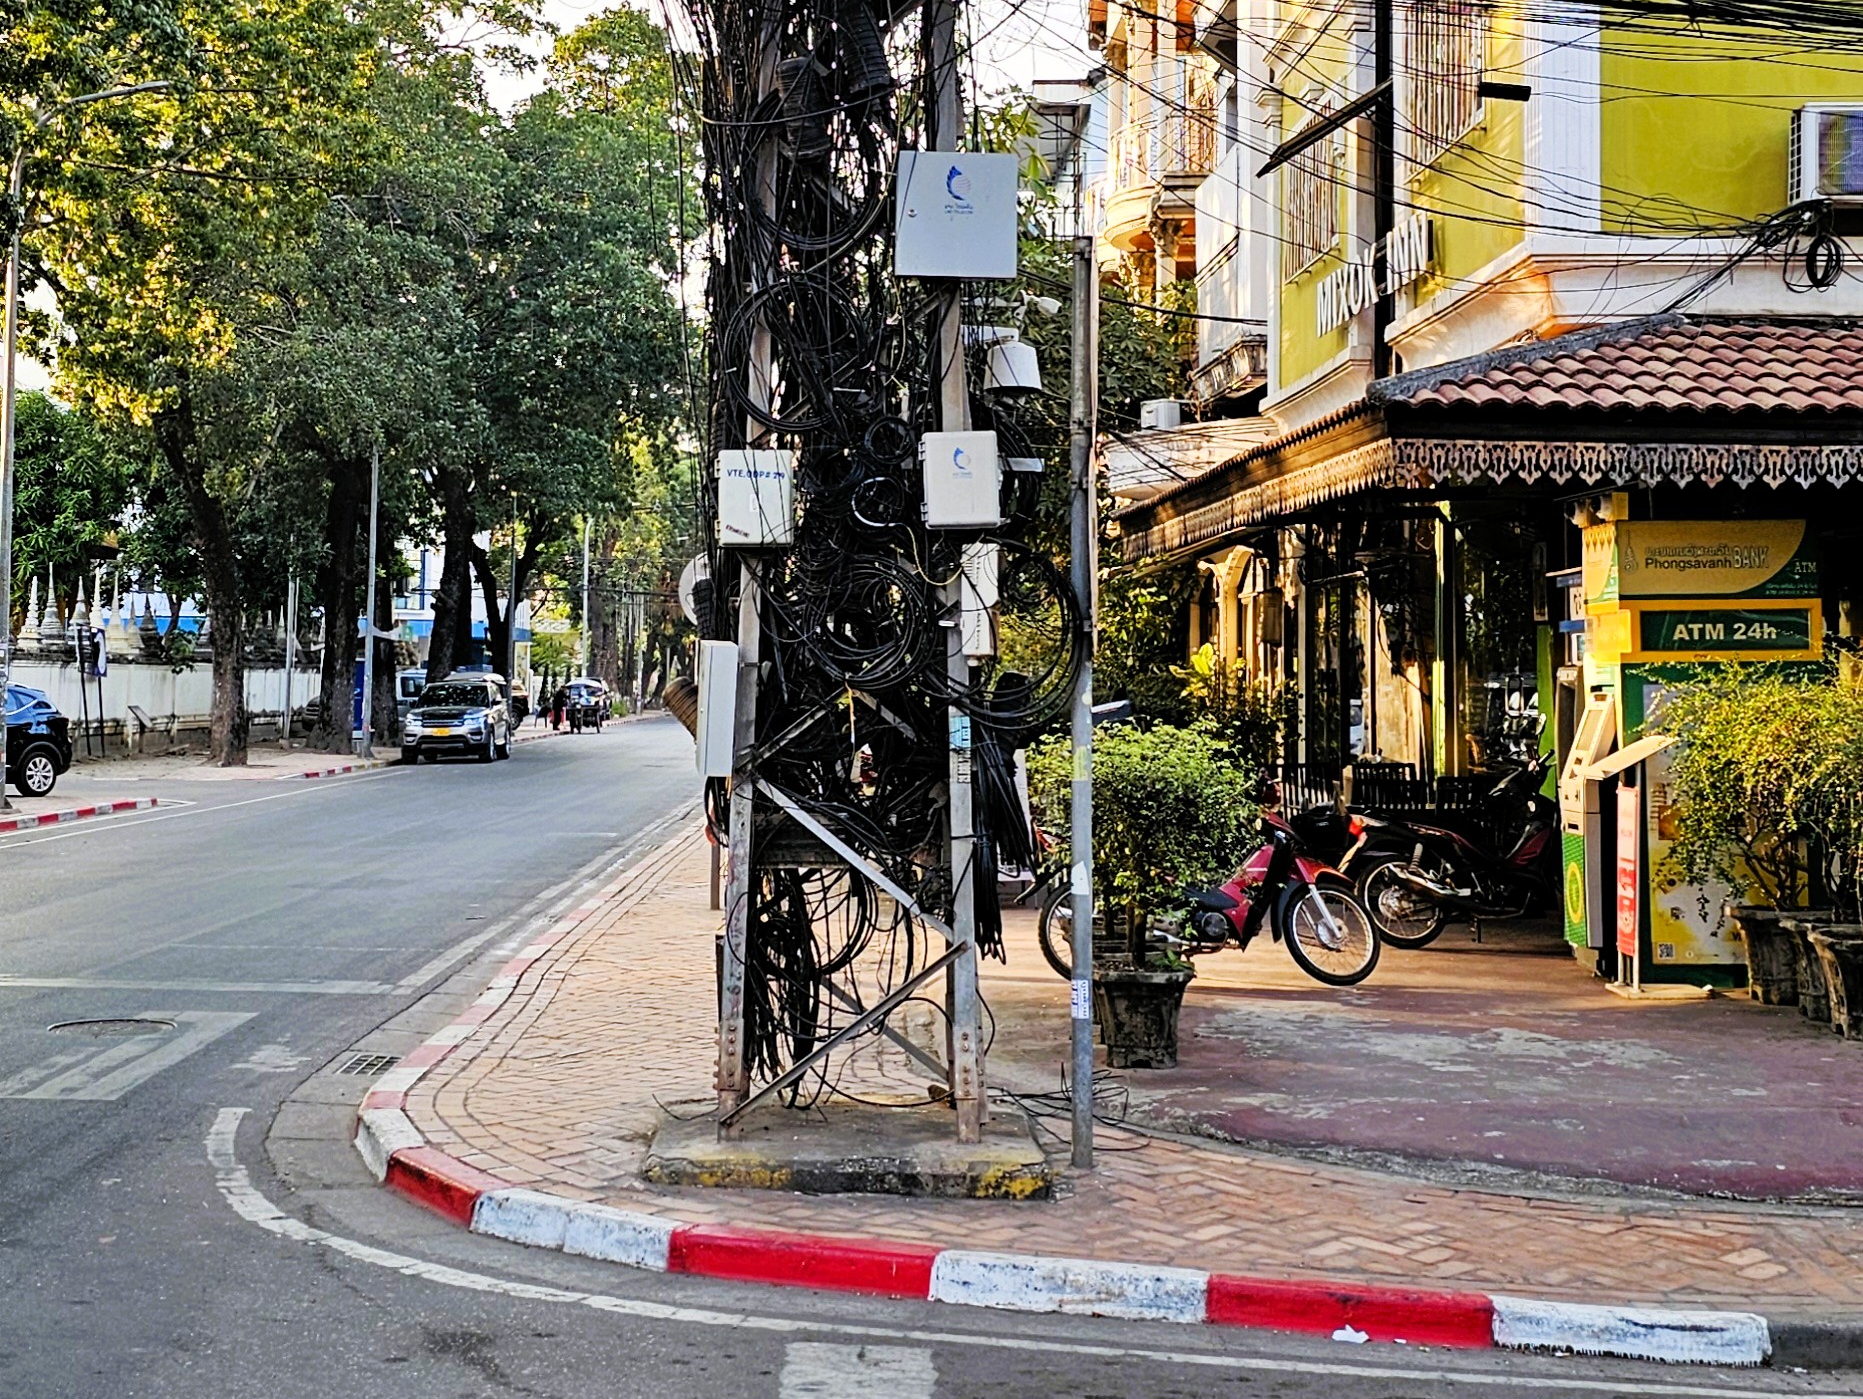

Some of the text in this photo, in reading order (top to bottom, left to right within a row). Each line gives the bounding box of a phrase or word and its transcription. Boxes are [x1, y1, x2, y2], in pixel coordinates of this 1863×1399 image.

[1317, 211, 1428, 338] MIXOK INN
[1645, 545, 1769, 572] Phongsavanh BANK
[1794, 561, 1817, 573] ATM
[1673, 622, 1777, 640] ATM 24h
